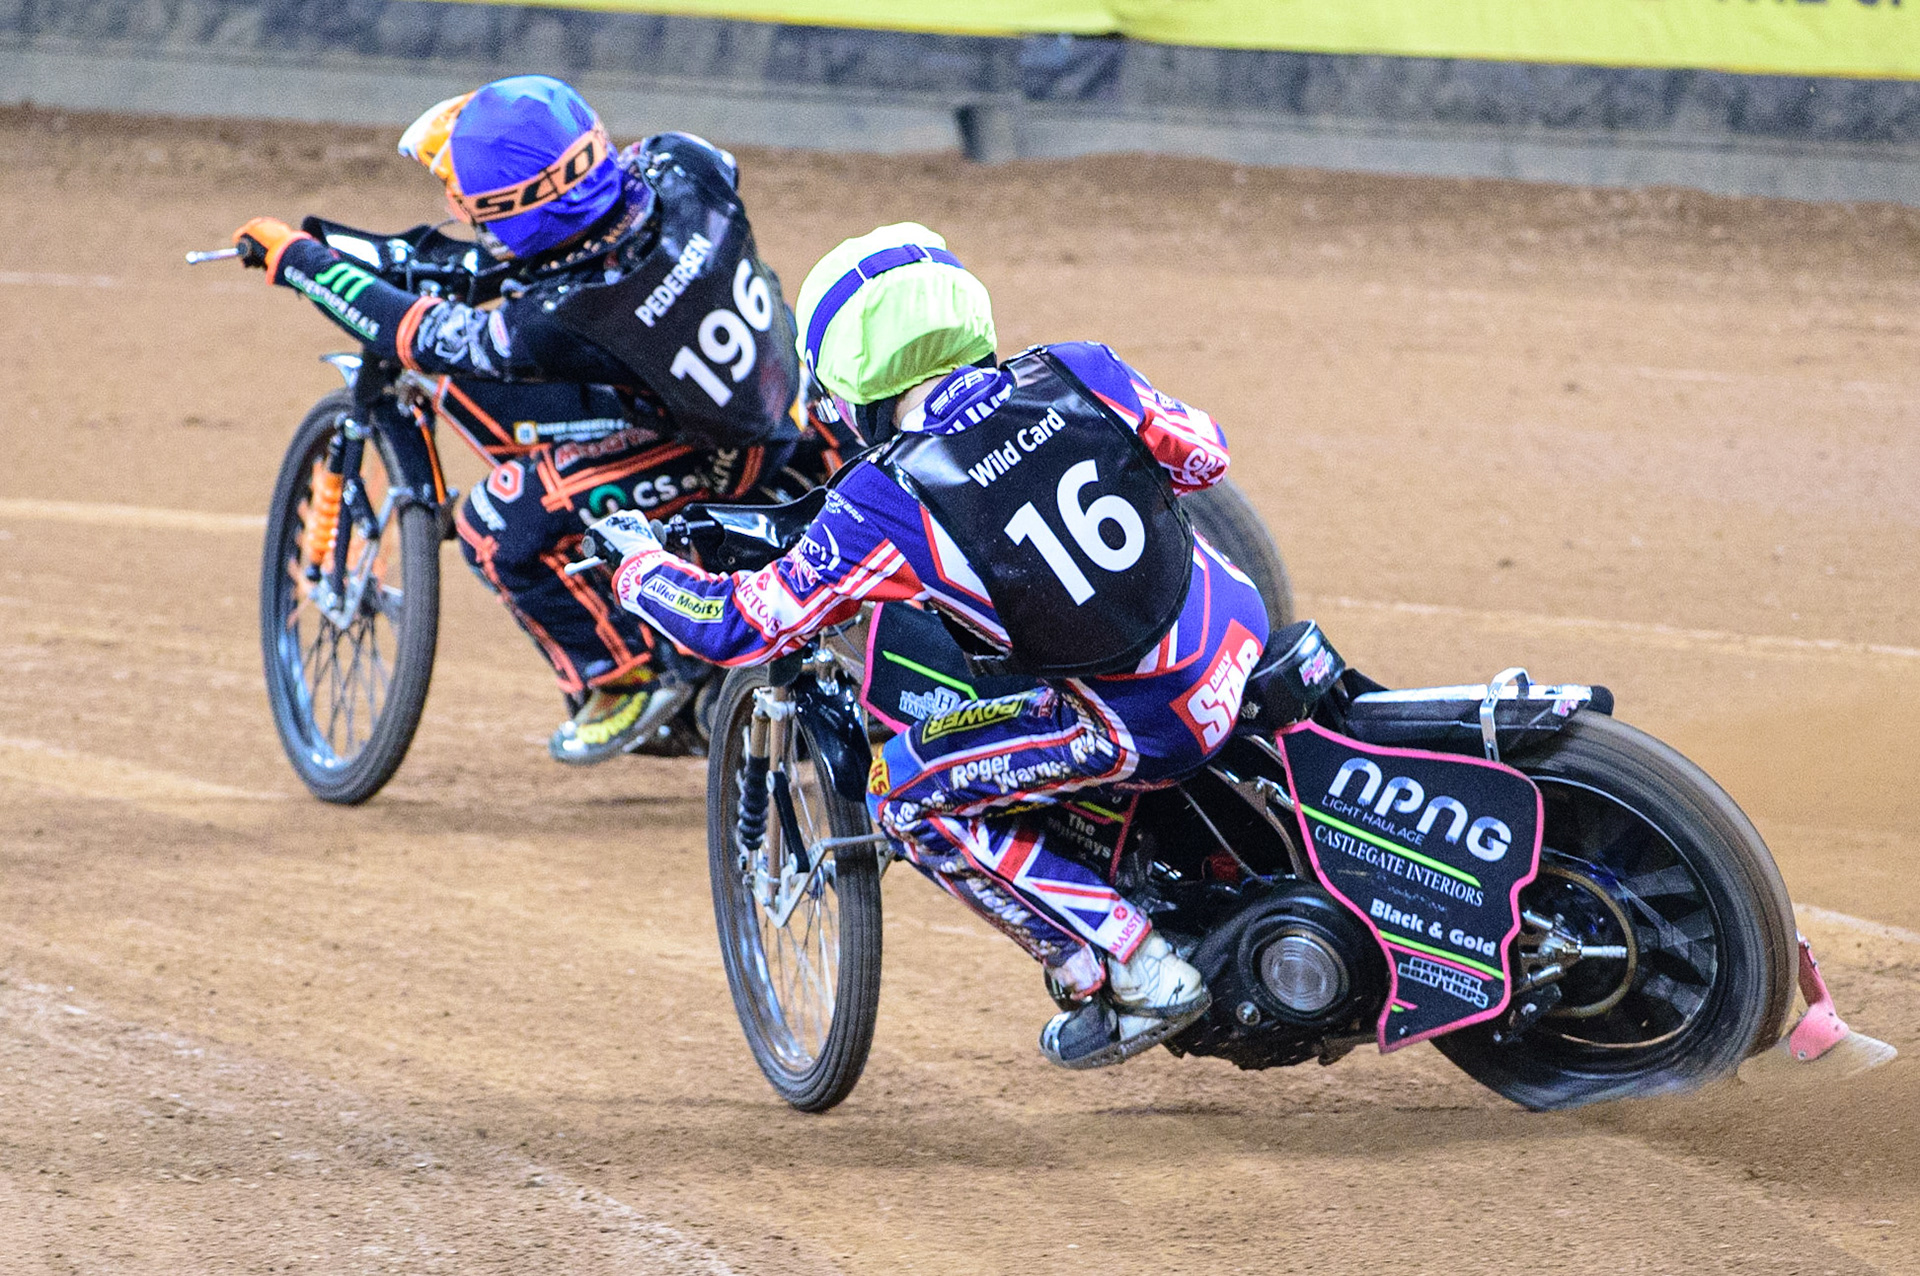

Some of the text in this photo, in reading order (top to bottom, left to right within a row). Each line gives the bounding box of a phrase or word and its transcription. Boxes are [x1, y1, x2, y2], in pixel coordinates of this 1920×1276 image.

[634, 232, 712, 328] PEDERSEN
[669, 258, 773, 408] 196
[967, 440, 1022, 488] Wild
[1016, 407, 1066, 452] Card
[1003, 459, 1146, 607] 16
[647, 580, 678, 602] Allied
[1187, 638, 1260, 748] STAR
[1209, 650, 1232, 689] DAILY
[928, 700, 1020, 735] POWER
[951, 753, 1011, 791] Roger
[1321, 795, 1425, 846] LIGHT HAULAGE
[1315, 824, 1402, 877] CASTLEGATE
[1406, 861, 1485, 907] INTERIORS
[1370, 898, 1425, 933] Black
[1428, 921, 1443, 940] &
[1449, 928, 1497, 957] Gold
